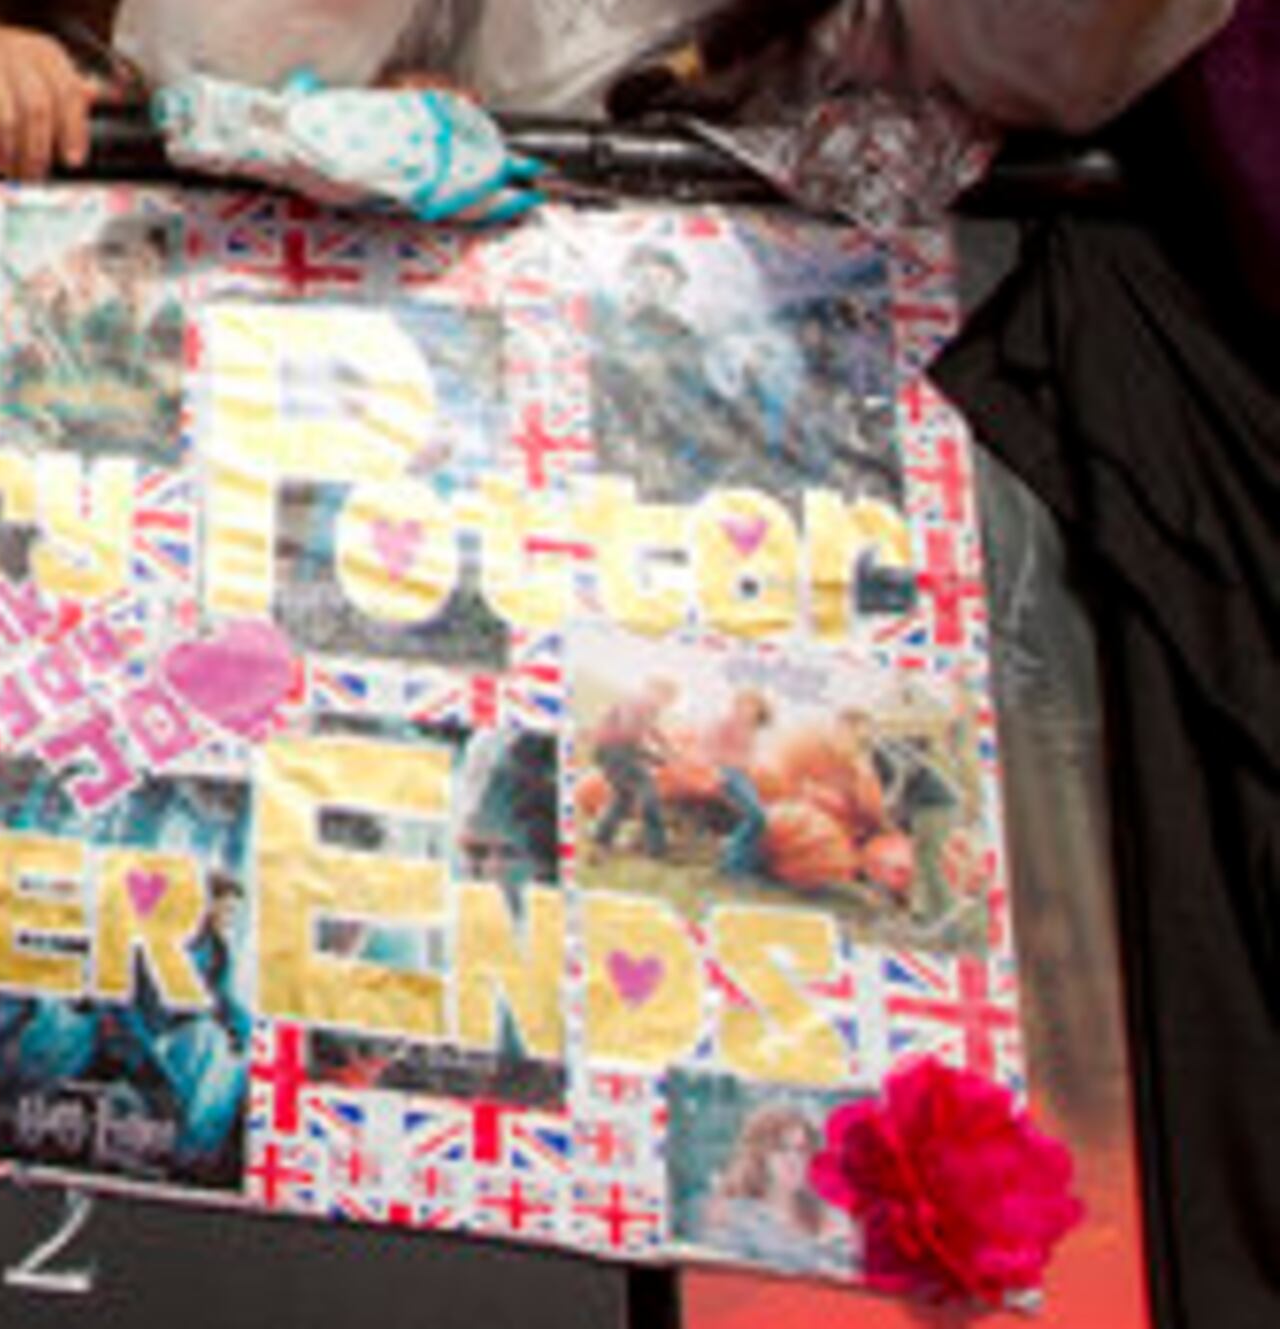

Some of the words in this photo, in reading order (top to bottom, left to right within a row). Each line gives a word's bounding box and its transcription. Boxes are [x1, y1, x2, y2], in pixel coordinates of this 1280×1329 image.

[200, 300, 914, 641] Potter
[256, 734, 852, 1088] ENDS
[4, 1187, 96, 1293] 2
